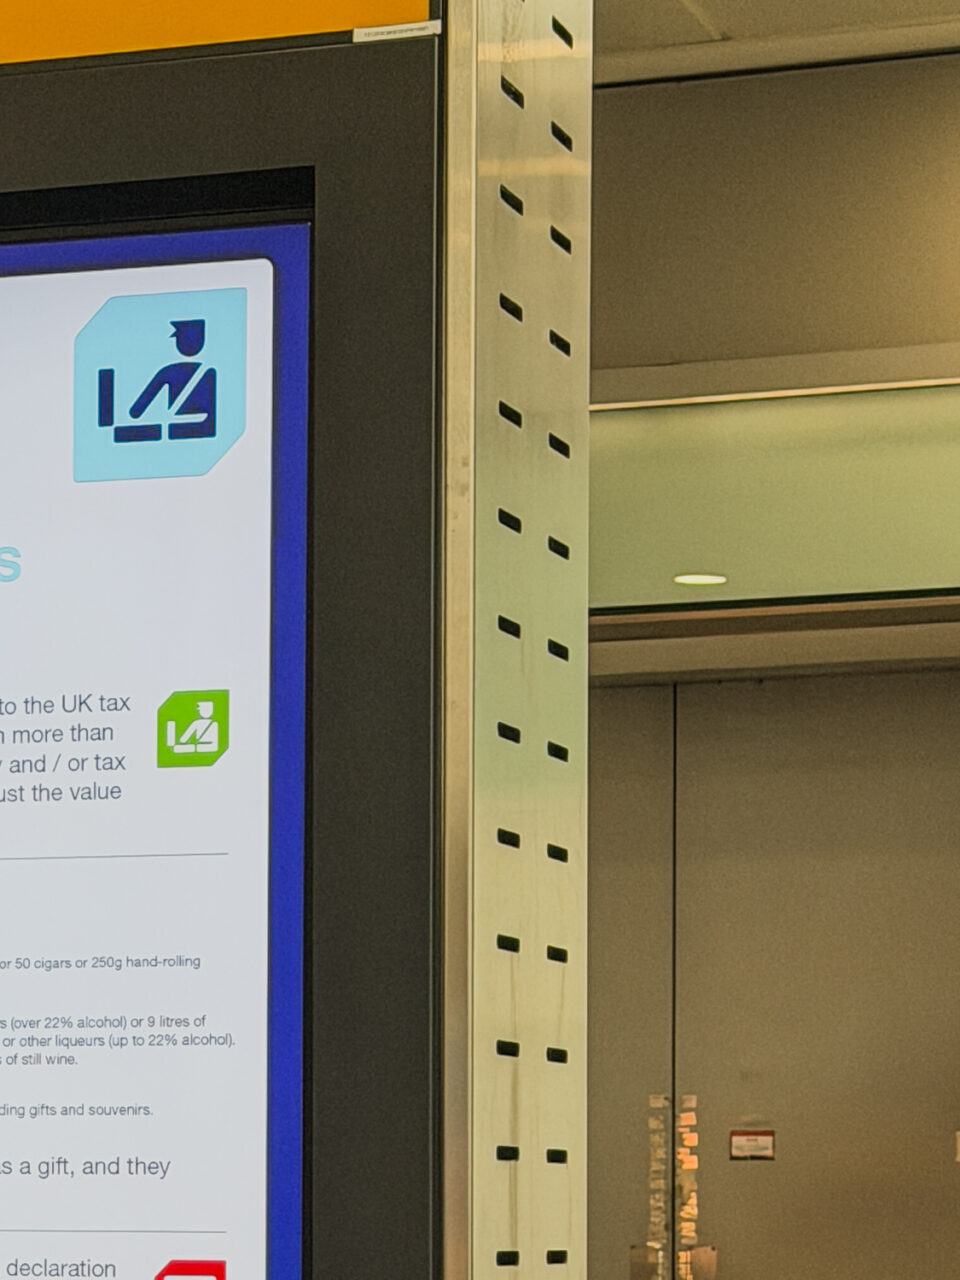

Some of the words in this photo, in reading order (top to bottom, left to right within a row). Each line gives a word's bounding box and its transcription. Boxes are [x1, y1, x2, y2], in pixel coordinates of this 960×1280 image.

[23, 696, 54, 716] the
[62, 693, 92, 713] UK
[99, 694, 131, 712] tax
[0, 960, 12, 970] or
[15, 957, 30, 970] 50
[34, 957, 72, 973] cigars
[75, 959, 88, 969] or
[91, 955, 122, 972] 250g
[126, 954, 200, 970] hand-rolling
[11, 1017, 41, 1032] (over
[44, 1016, 73, 1030] 22%
[77, 1015, 127, 1031] alcohol)
[130, 1017, 144, 1029] or
[147, 1015, 155, 1028] 9
[160, 1015, 190, 1028] litres
[194, 1015, 206, 1027] of
[2, 1037, 16, 1048] or
[19, 1034, 52, 1047] other
[55, 1034, 105, 1050] liqueurs
[108, 1033, 128, 1050] (up
[132, 1035, 145, 1047] to
[148, 1033, 177, 1046] 22%
[182, 1032, 235, 1048] alcohol).
[29, 1103, 57, 1120] gifts
[60, 1103, 84, 1117] and
[88, 1103, 153, 1116] souvenirs.
[6, 1258, 116, 1278] declaration
